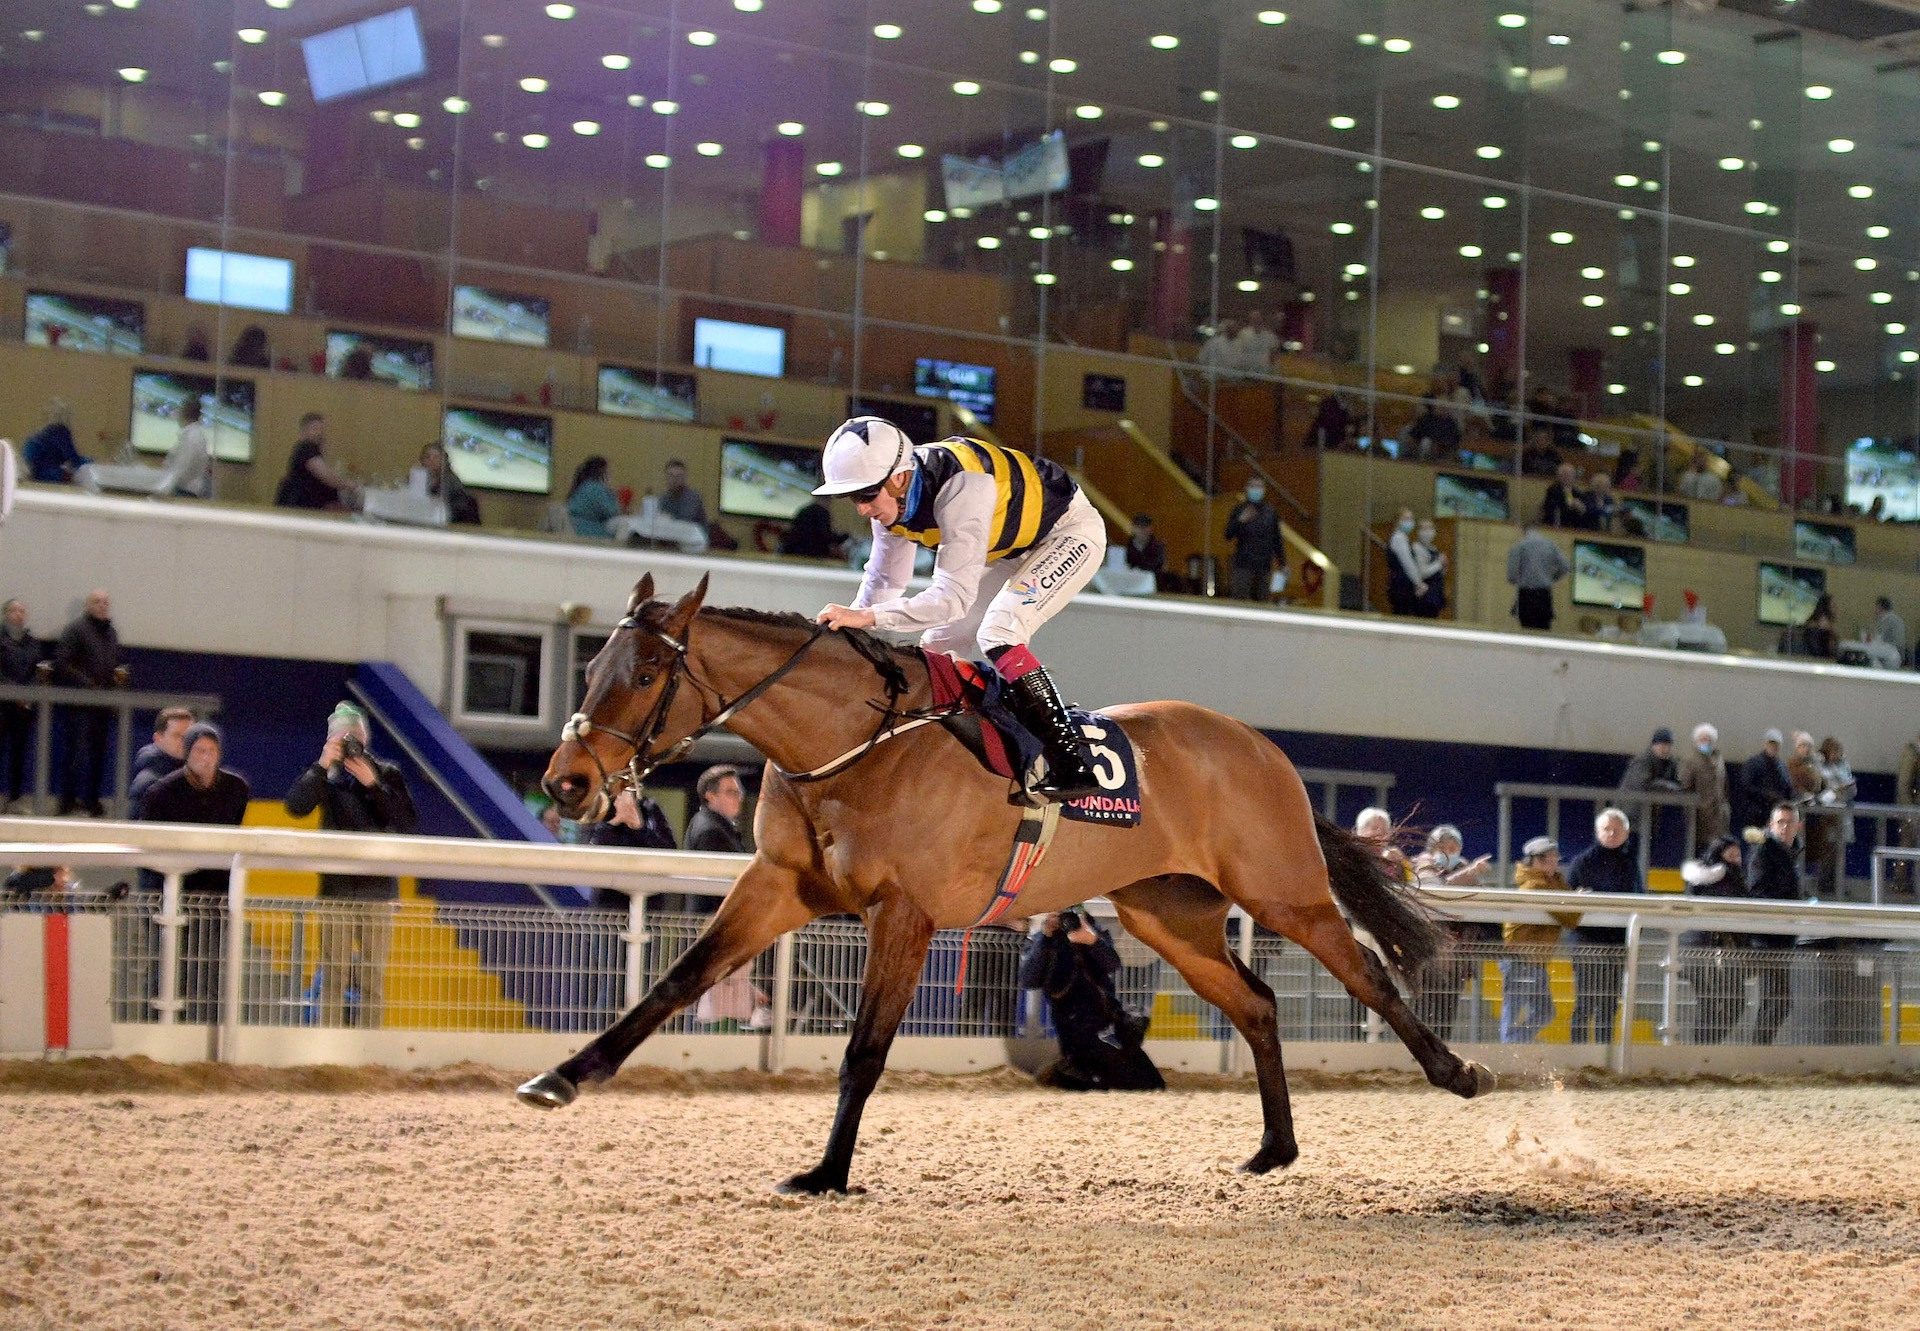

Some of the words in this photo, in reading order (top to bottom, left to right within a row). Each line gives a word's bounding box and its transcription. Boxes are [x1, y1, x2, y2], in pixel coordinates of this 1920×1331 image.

[1041, 543, 1088, 589] Crumlin
[1080, 724, 1126, 790] 5
[1084, 810, 1132, 820] STADIUM
